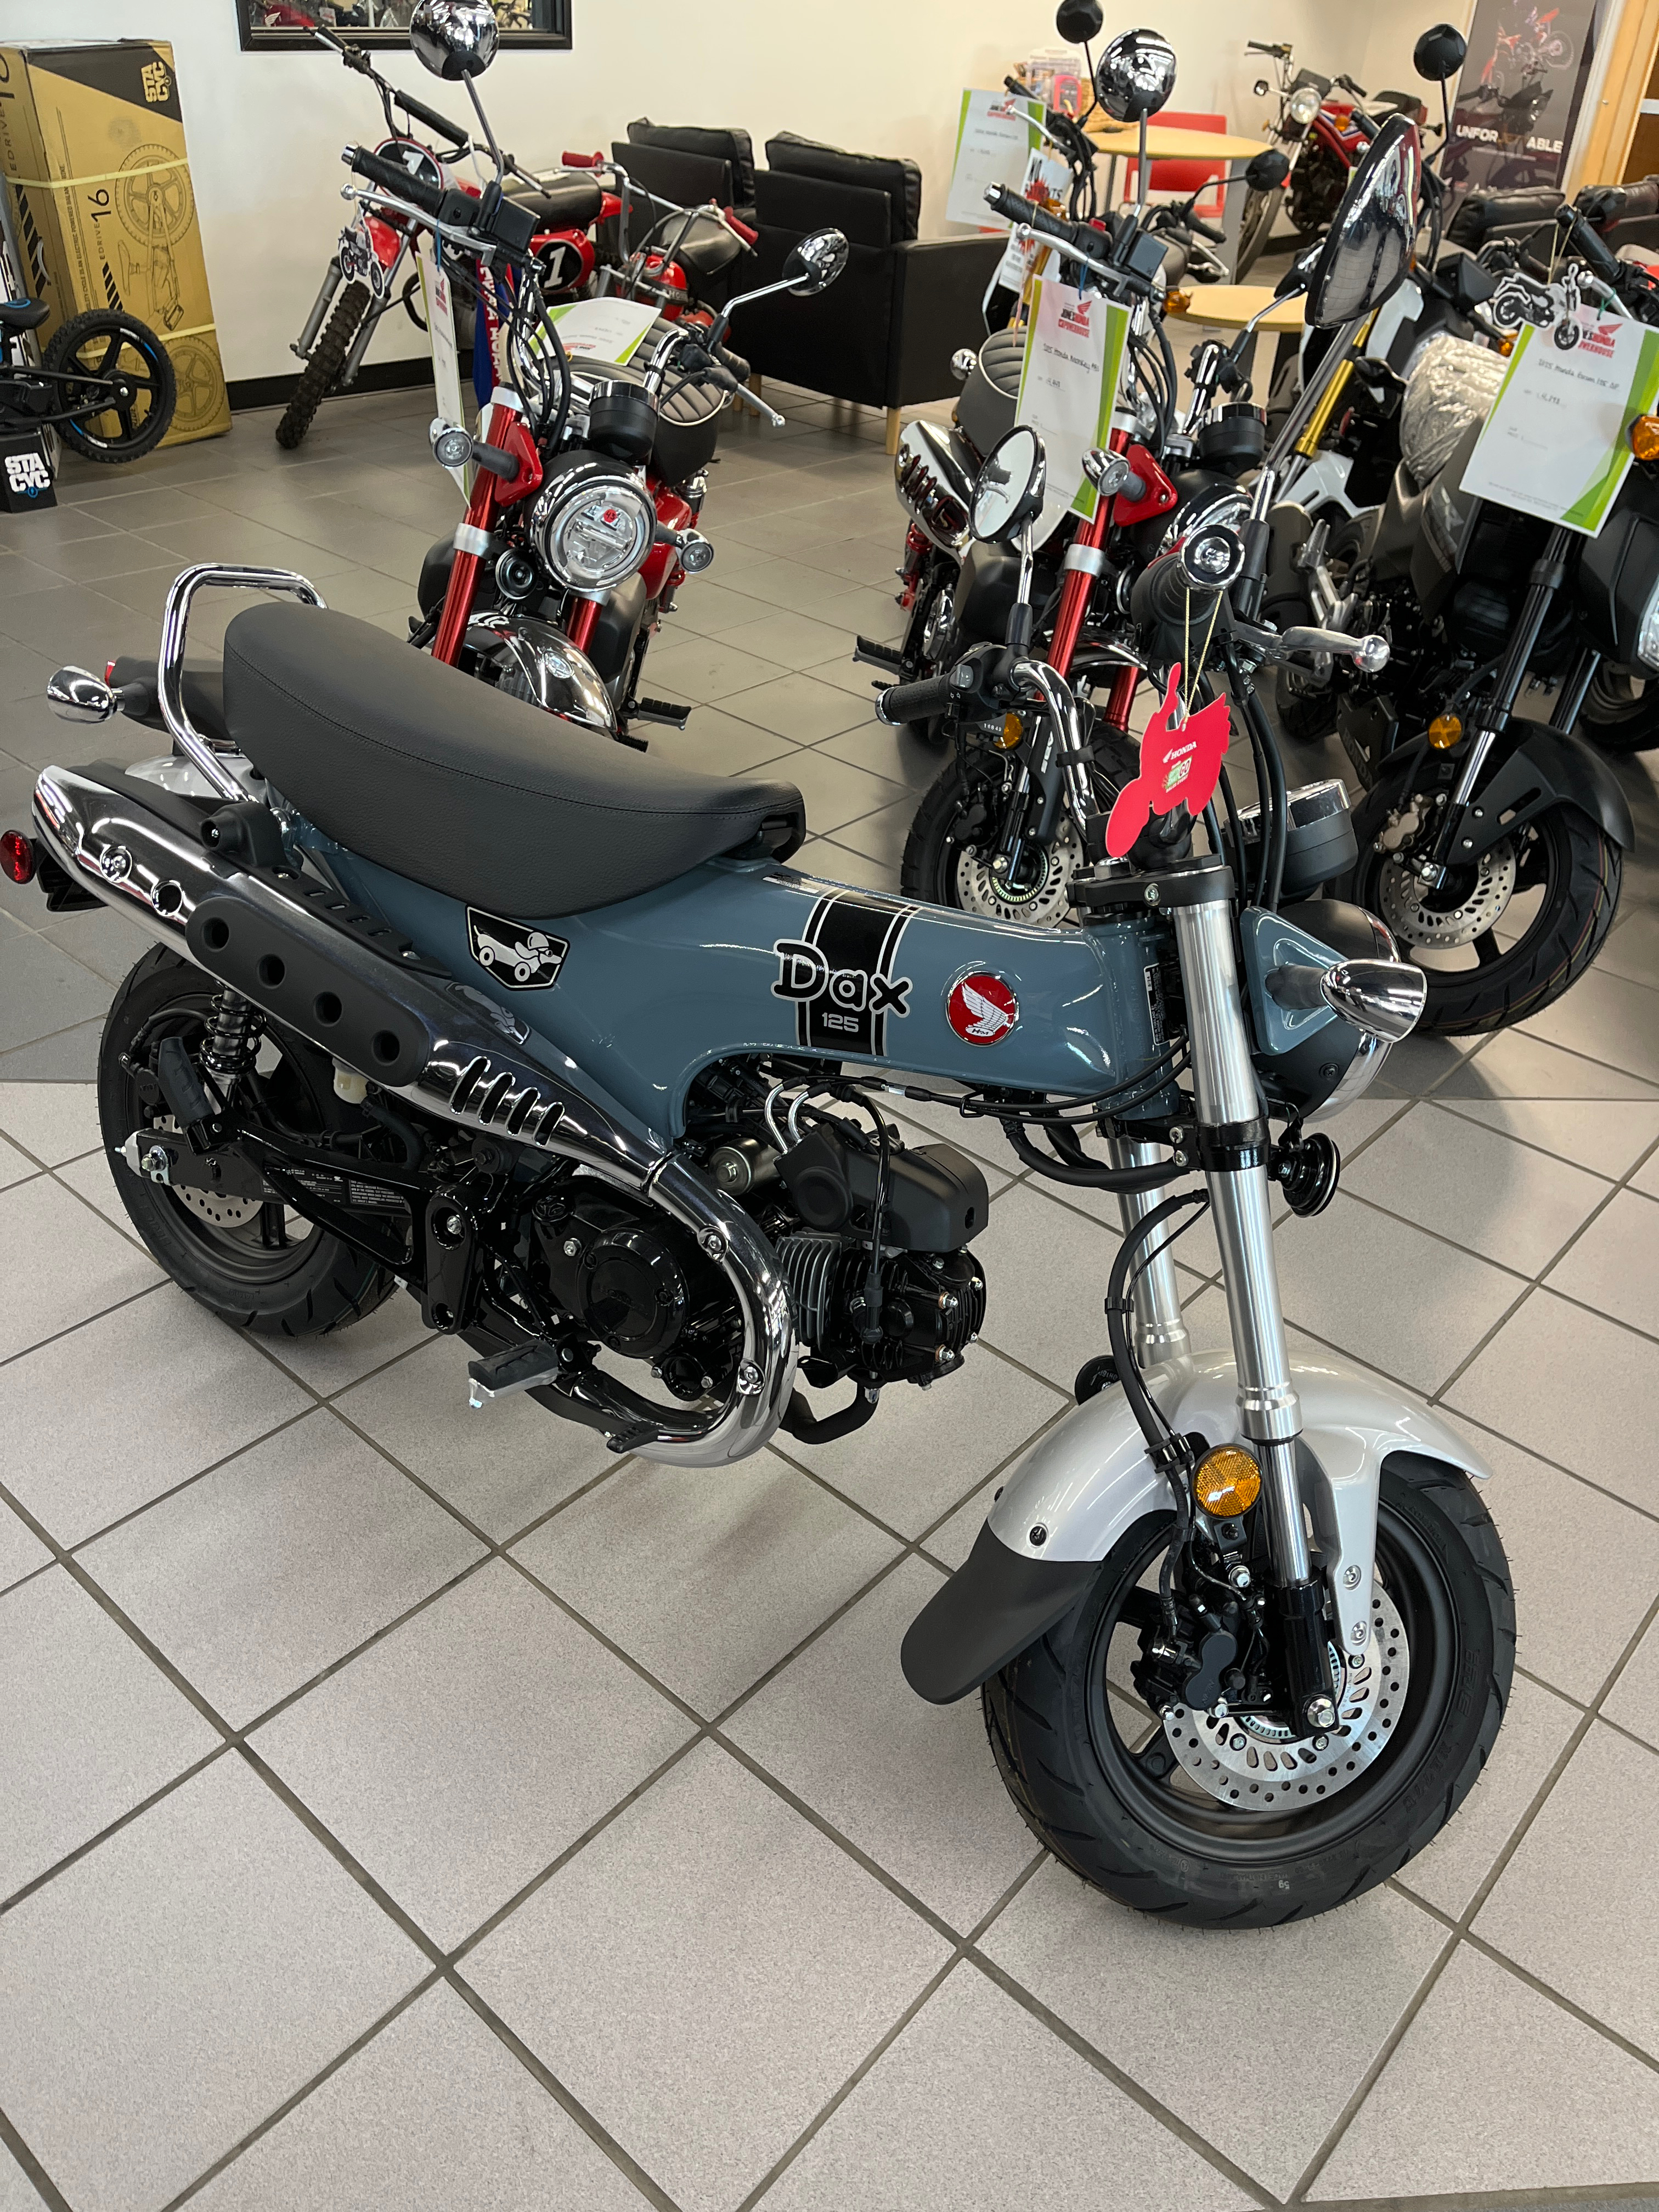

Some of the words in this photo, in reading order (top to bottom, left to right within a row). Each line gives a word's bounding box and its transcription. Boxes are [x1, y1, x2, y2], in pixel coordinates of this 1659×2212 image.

[141, 64, 157, 103] STA
[152, 61, 170, 101] CYC
[87, 189, 111, 222] 16
[93, 222, 105, 260] EDRIVE
[544, 246, 566, 288] 1
[4, 453, 45, 475] STA
[9, 470, 50, 493] CYC
[1170, 741, 1197, 760] HONDA
[1180, 760, 1190, 777] GO
[771, 939, 913, 1018] Dax
[822, 1012, 859, 1032] 125
